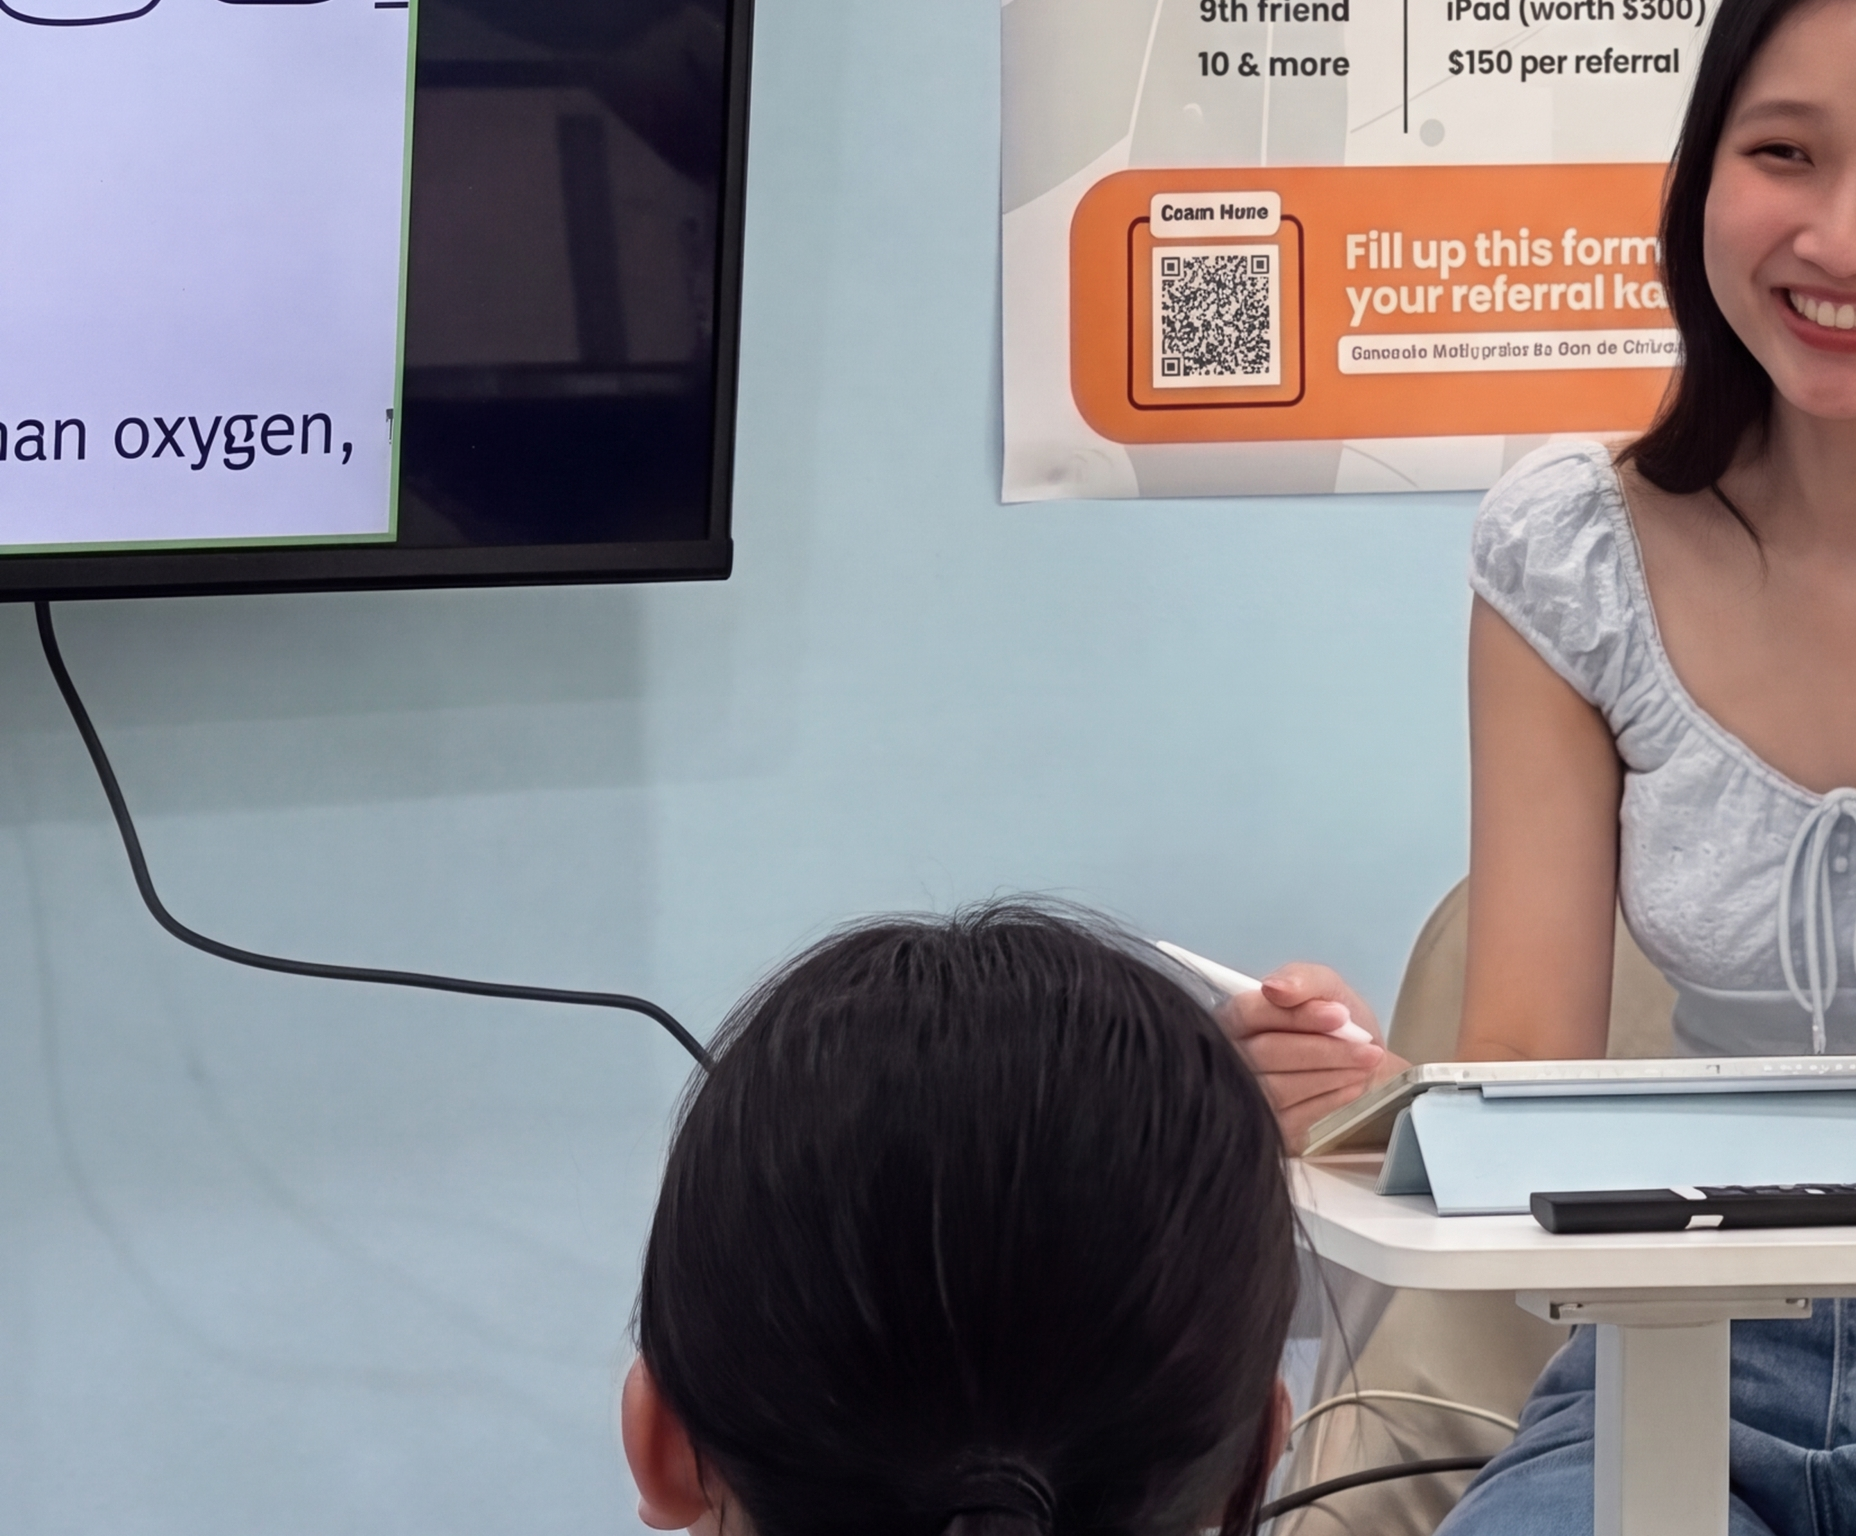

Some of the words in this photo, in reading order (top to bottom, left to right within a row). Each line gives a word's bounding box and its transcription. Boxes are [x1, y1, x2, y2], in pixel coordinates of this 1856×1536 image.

[1198, 51, 1230, 77] 10
[1237, 52, 1261, 77] &
[1269, 56, 1350, 77] more
[1448, 49, 1513, 76] $150
[1520, 55, 1568, 83] per
[1575, 47, 1679, 74] referral
[1346, 230, 1402, 269] Fill
[1413, 239, 1466, 279] up
[1475, 227, 1553, 267] this
[1346, 285, 1443, 327] your
[1452, 273, 1604, 313] referral
[0, 416, 87, 462] an
[113, 409, 354, 471] oxygen,
